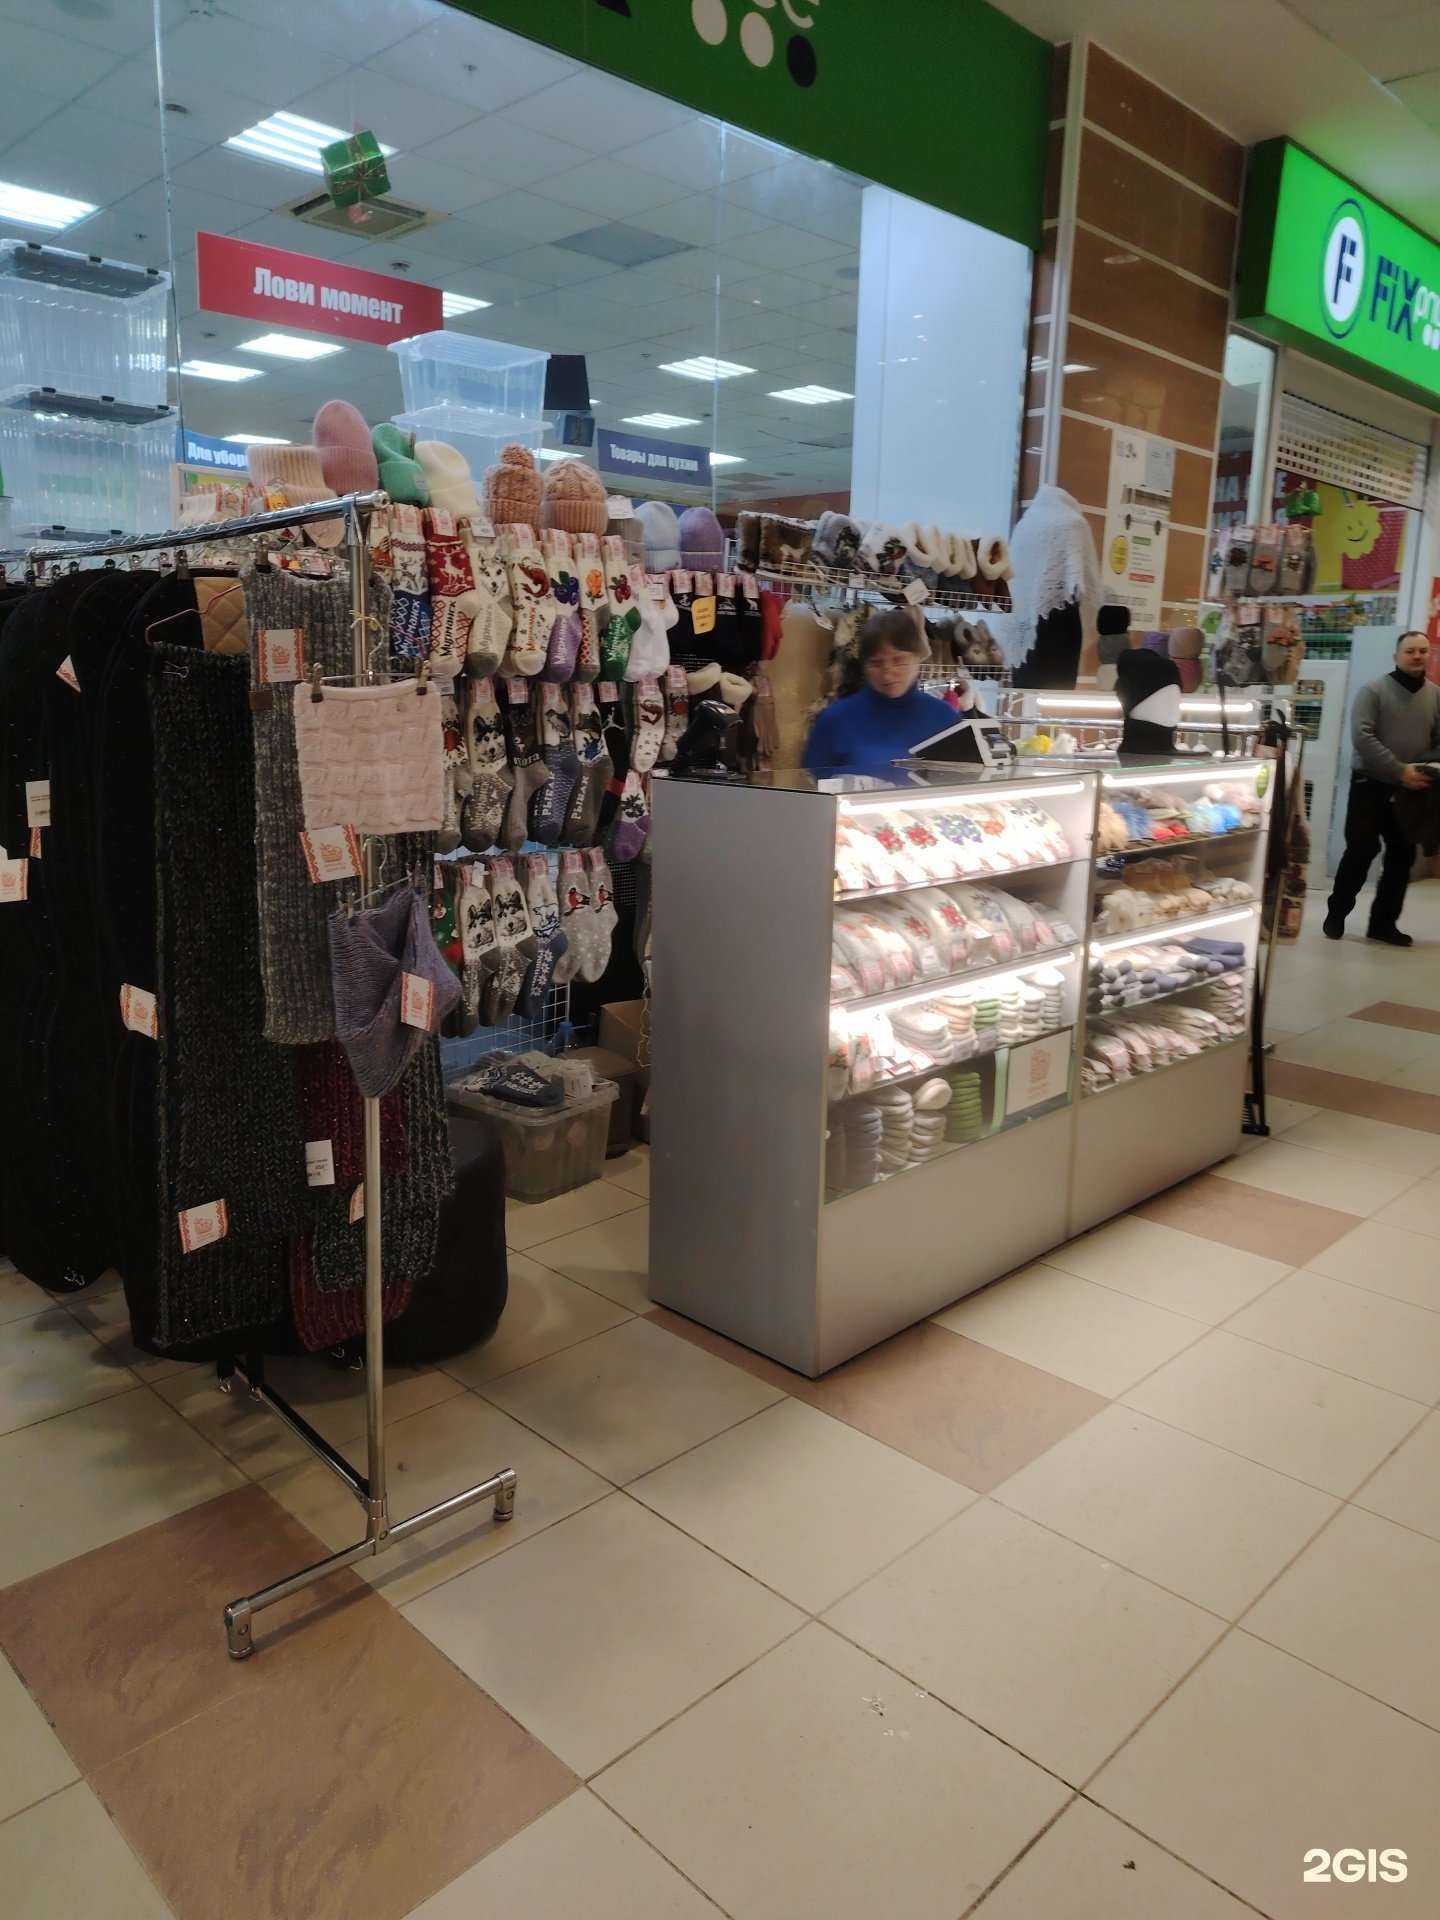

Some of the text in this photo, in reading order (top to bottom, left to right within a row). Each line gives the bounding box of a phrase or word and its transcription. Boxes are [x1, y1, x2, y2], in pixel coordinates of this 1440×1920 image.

[253, 266, 404, 324] Лови момент
[439, 600, 457, 657] Мурманск
